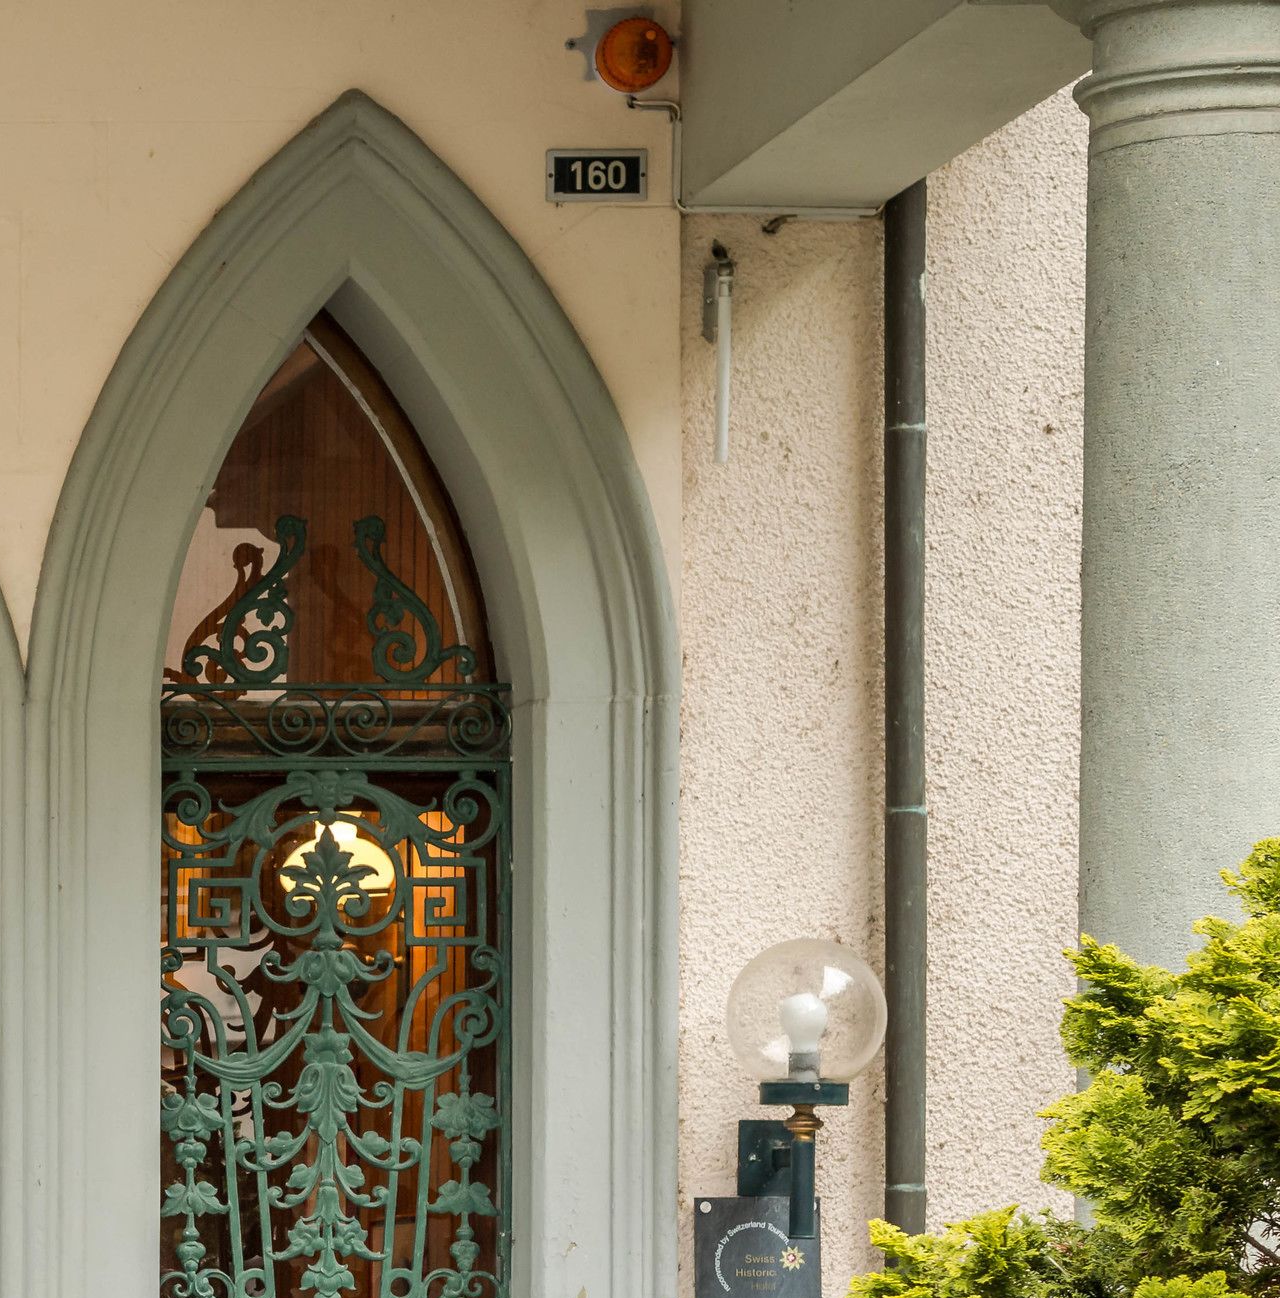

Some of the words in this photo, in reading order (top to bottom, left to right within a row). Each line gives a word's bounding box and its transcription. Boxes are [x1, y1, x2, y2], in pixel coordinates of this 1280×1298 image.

[570, 160, 626, 190] 160
[727, 1221, 766, 1237] Switzerland
[720, 1235, 730, 1245] by
[744, 1254, 776, 1264] Swiss
[714, 1243, 731, 1292] recommended
[735, 1268, 776, 1277] Historic
